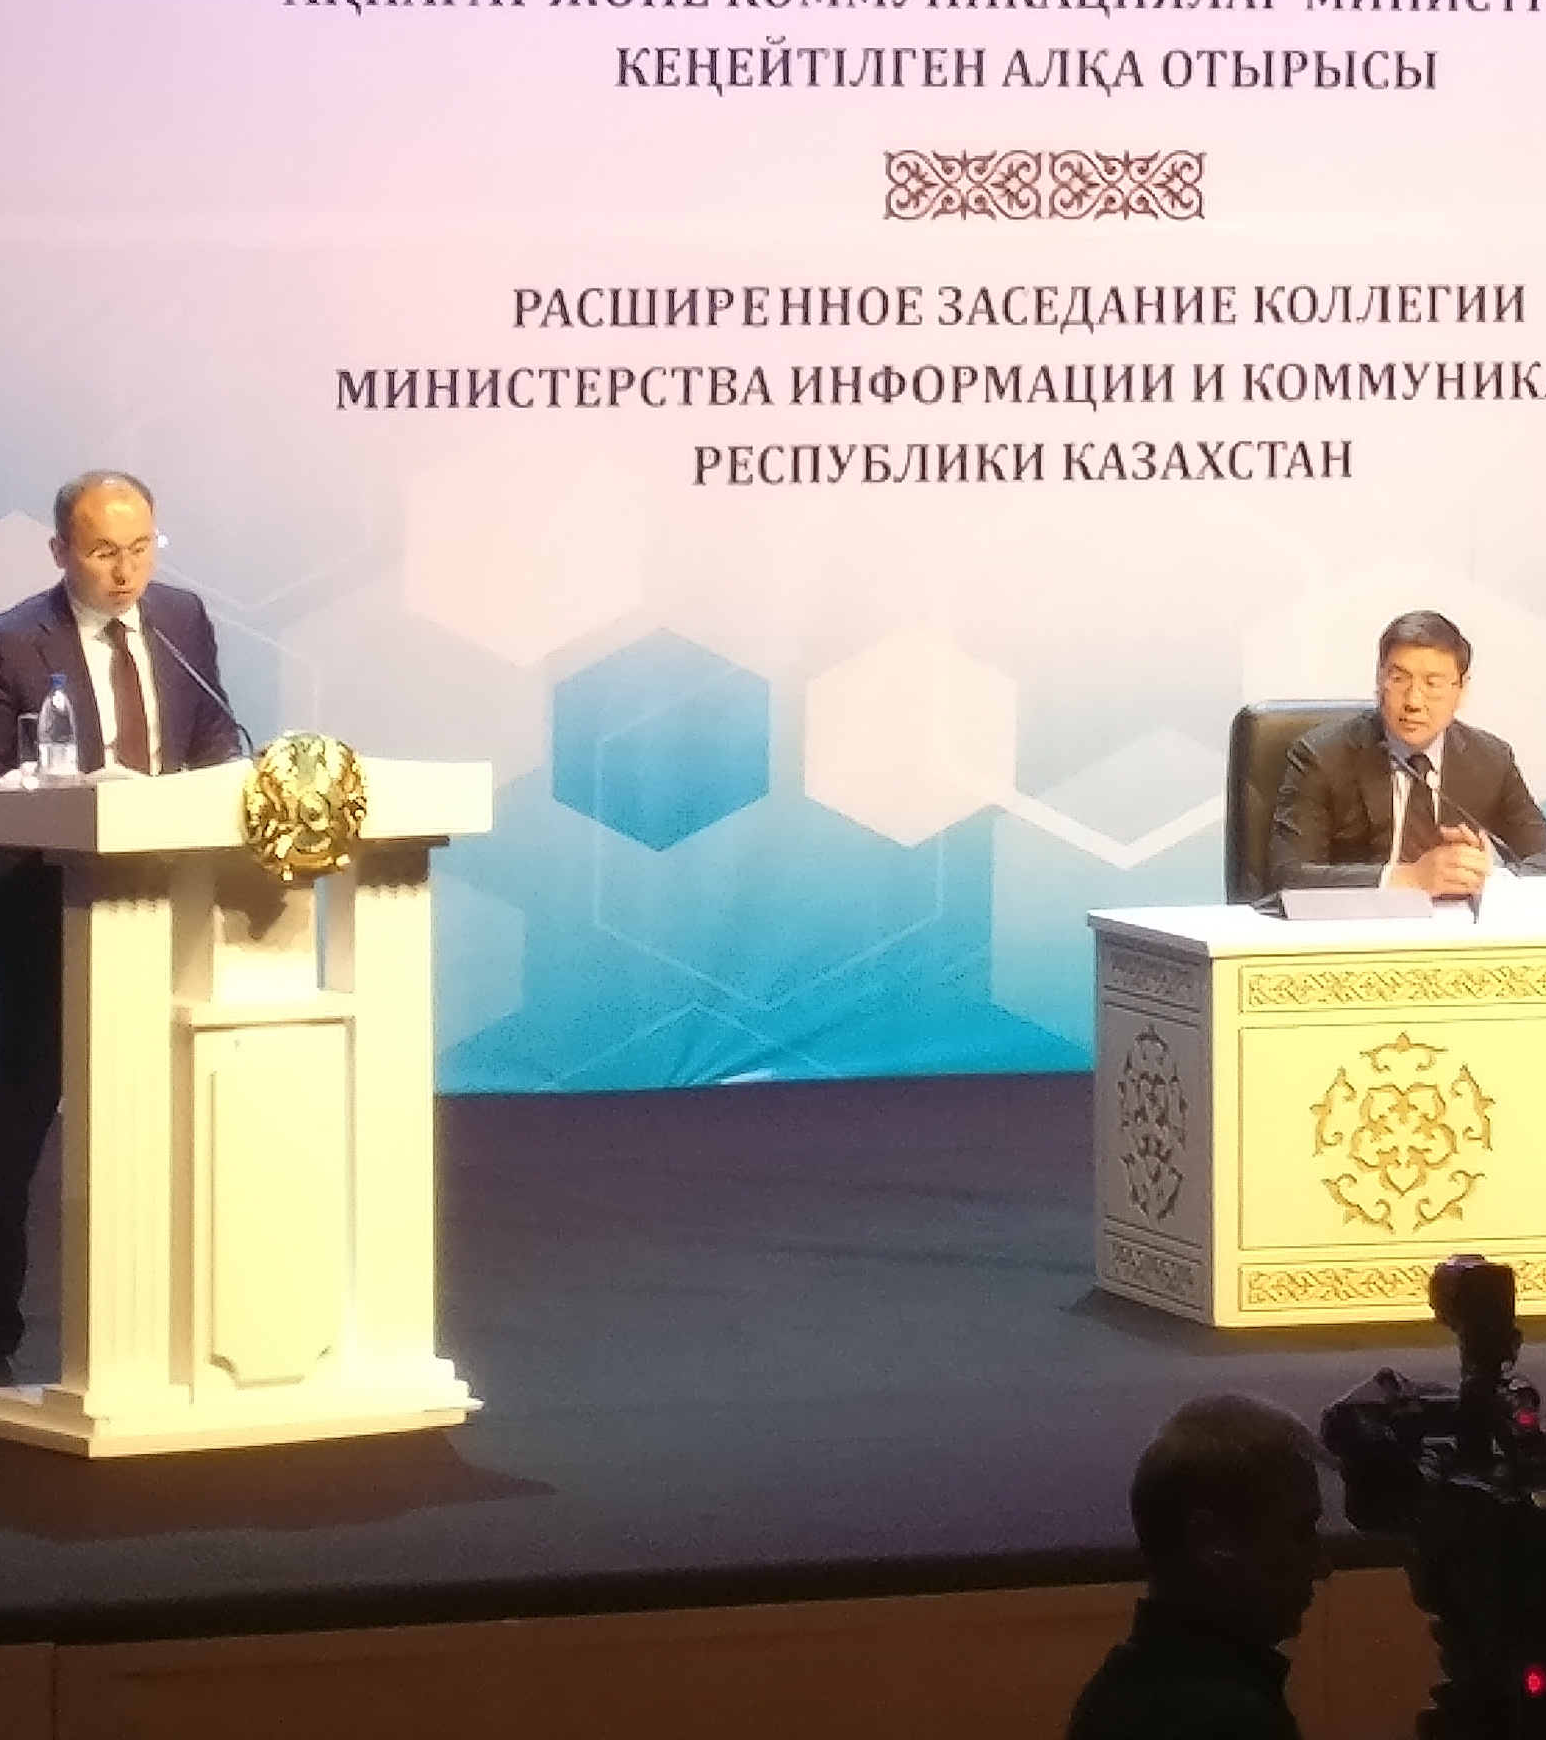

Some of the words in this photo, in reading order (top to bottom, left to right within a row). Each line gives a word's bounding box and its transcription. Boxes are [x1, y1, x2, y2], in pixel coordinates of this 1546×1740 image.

[615, 35, 987, 97] КЕҢЕЙТІЛГЕН
[1002, 49, 1145, 97] АЛҚА
[1162, 49, 1438, 91] ОТЫРЫСЫ
[514, 284, 924, 328] РАСШИРЕННОЕ
[938, 284, 1237, 335] ЗАСЕДАНИЕ
[1254, 283, 1526, 325] КОЛЛЕГИИ
[336, 365, 774, 411] МИНИСТЕРСТВА
[790, 363, 1175, 413] ИНФОРМАЦИИ
[1192, 363, 1225, 403] И
[692, 442, 1045, 488] РЕСПУБЛИКИ
[1062, 440, 1353, 482] КАЗАХСТАН
